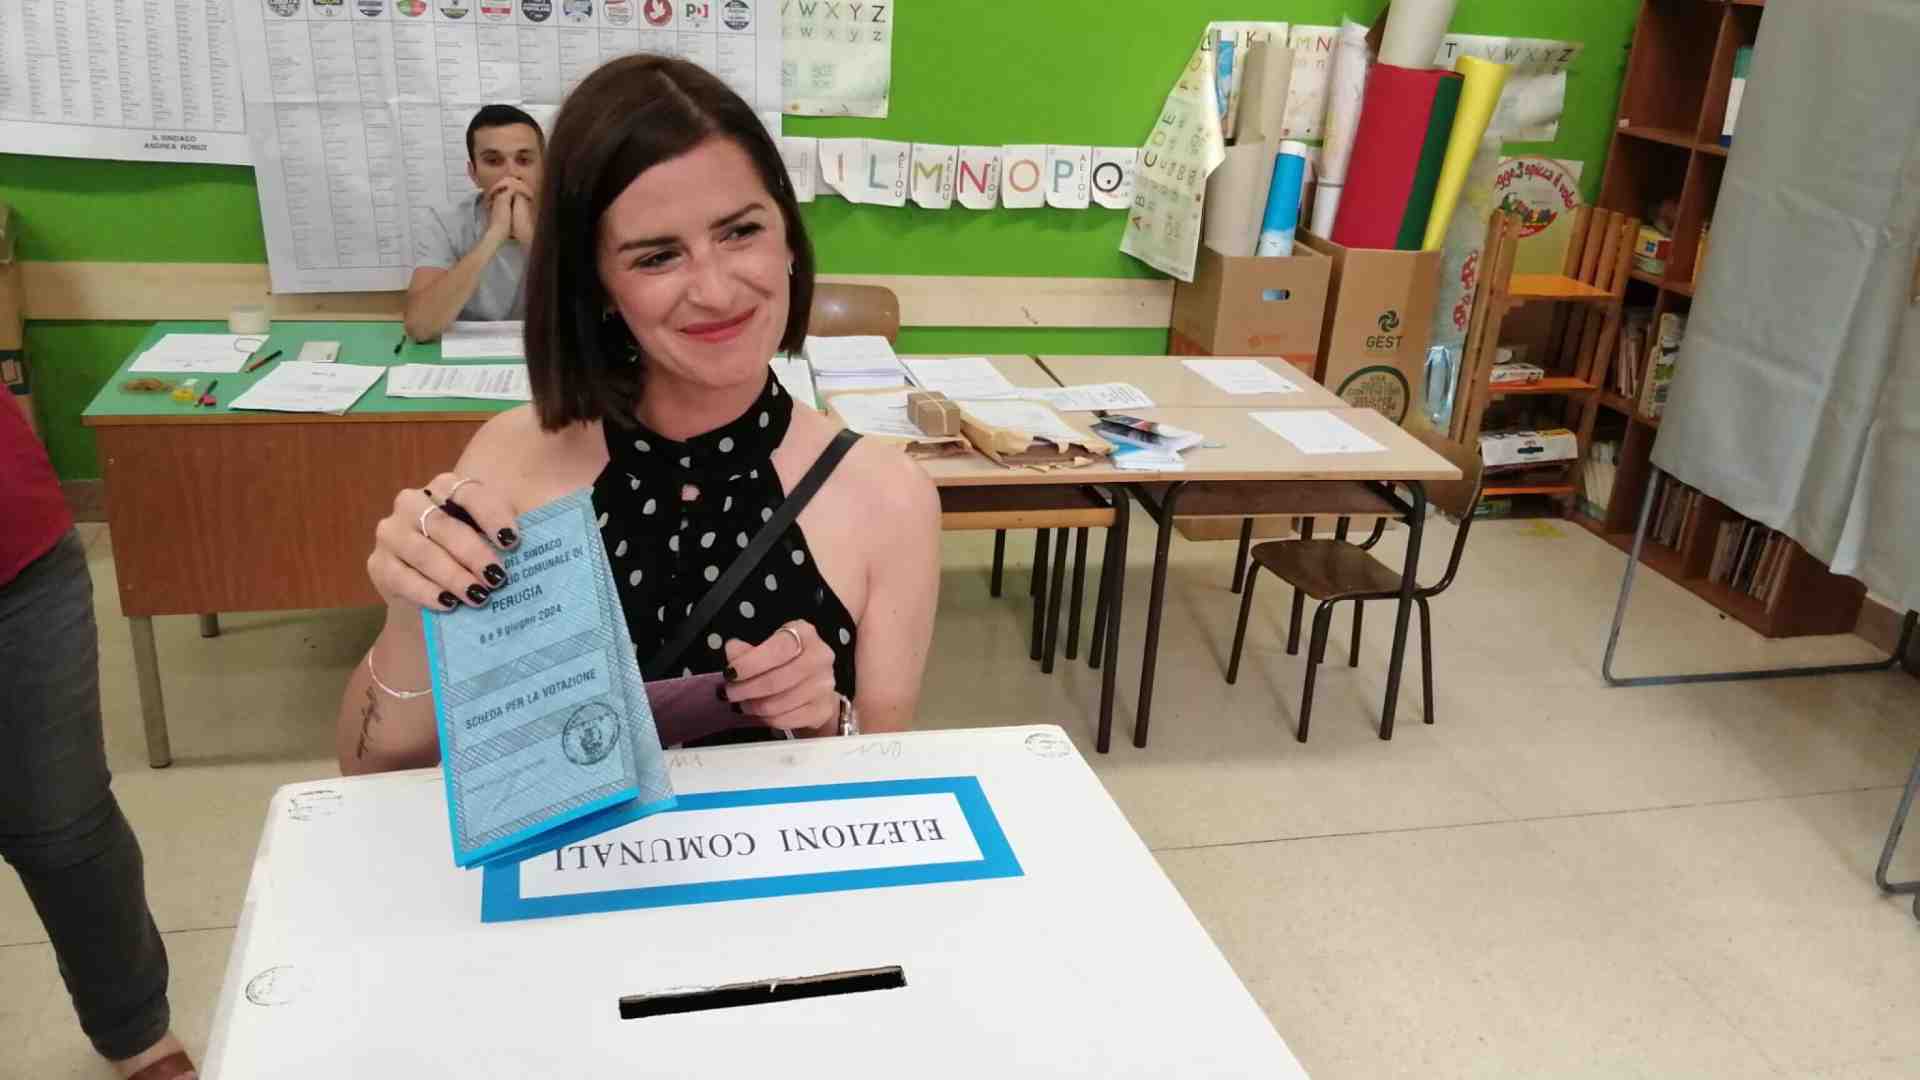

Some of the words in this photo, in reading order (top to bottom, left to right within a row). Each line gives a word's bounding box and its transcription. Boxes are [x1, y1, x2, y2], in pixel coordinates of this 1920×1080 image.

[799, 0, 817, 16] W
[824, 1, 840, 19] X
[849, 2, 863, 21] Y
[871, 5, 886, 23] Z
[1315, 36, 1332, 51] N
[1445, 42, 1458, 58] T
[1557, 48, 1576, 63] Z
[868, 154, 889, 189] L
[913, 160, 943, 193] M
[959, 161, 991, 194] N
[1009, 159, 1040, 193] O
[1053, 159, 1074, 193] P
[1365, 335, 1404, 349] GEST
[523, 537, 563, 561] SINDACO
[521, 551, 572, 580] COMUNALE
[491, 583, 544, 614] PERUGIA
[537, 603, 563, 621] 2024
[465, 706, 505, 731] SCHEDA
[504, 696, 526, 715] PER
[526, 691, 541, 705] LA
[541, 668, 598, 700] VOTAZIONE
[781, 818, 945, 852] ELEZIONI
[554, 831, 757, 871] COMUNALI
